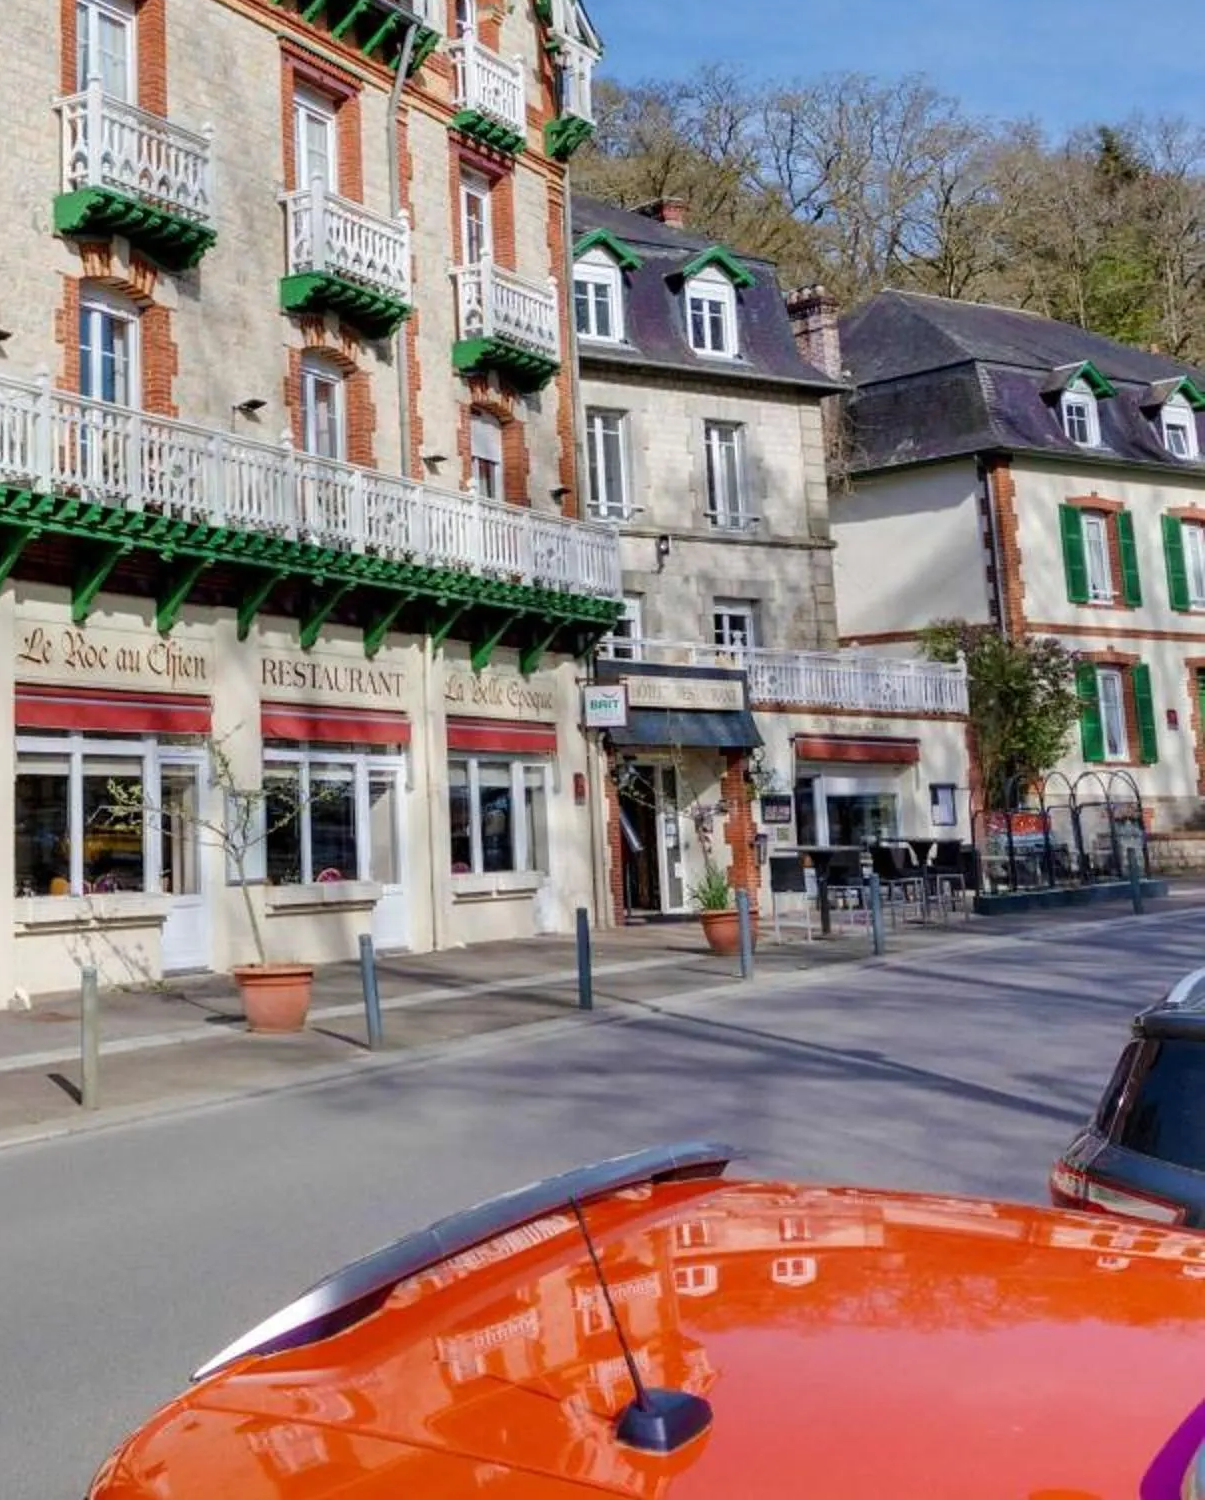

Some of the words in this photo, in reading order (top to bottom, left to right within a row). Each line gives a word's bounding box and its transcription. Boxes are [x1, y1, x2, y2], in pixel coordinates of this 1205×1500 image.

[18, 627, 52, 664] Le
[62, 629, 108, 670] Roc
[115, 647, 141, 673] au
[147, 640, 207, 690] Chien
[260, 657, 406, 698] RESTAURANT
